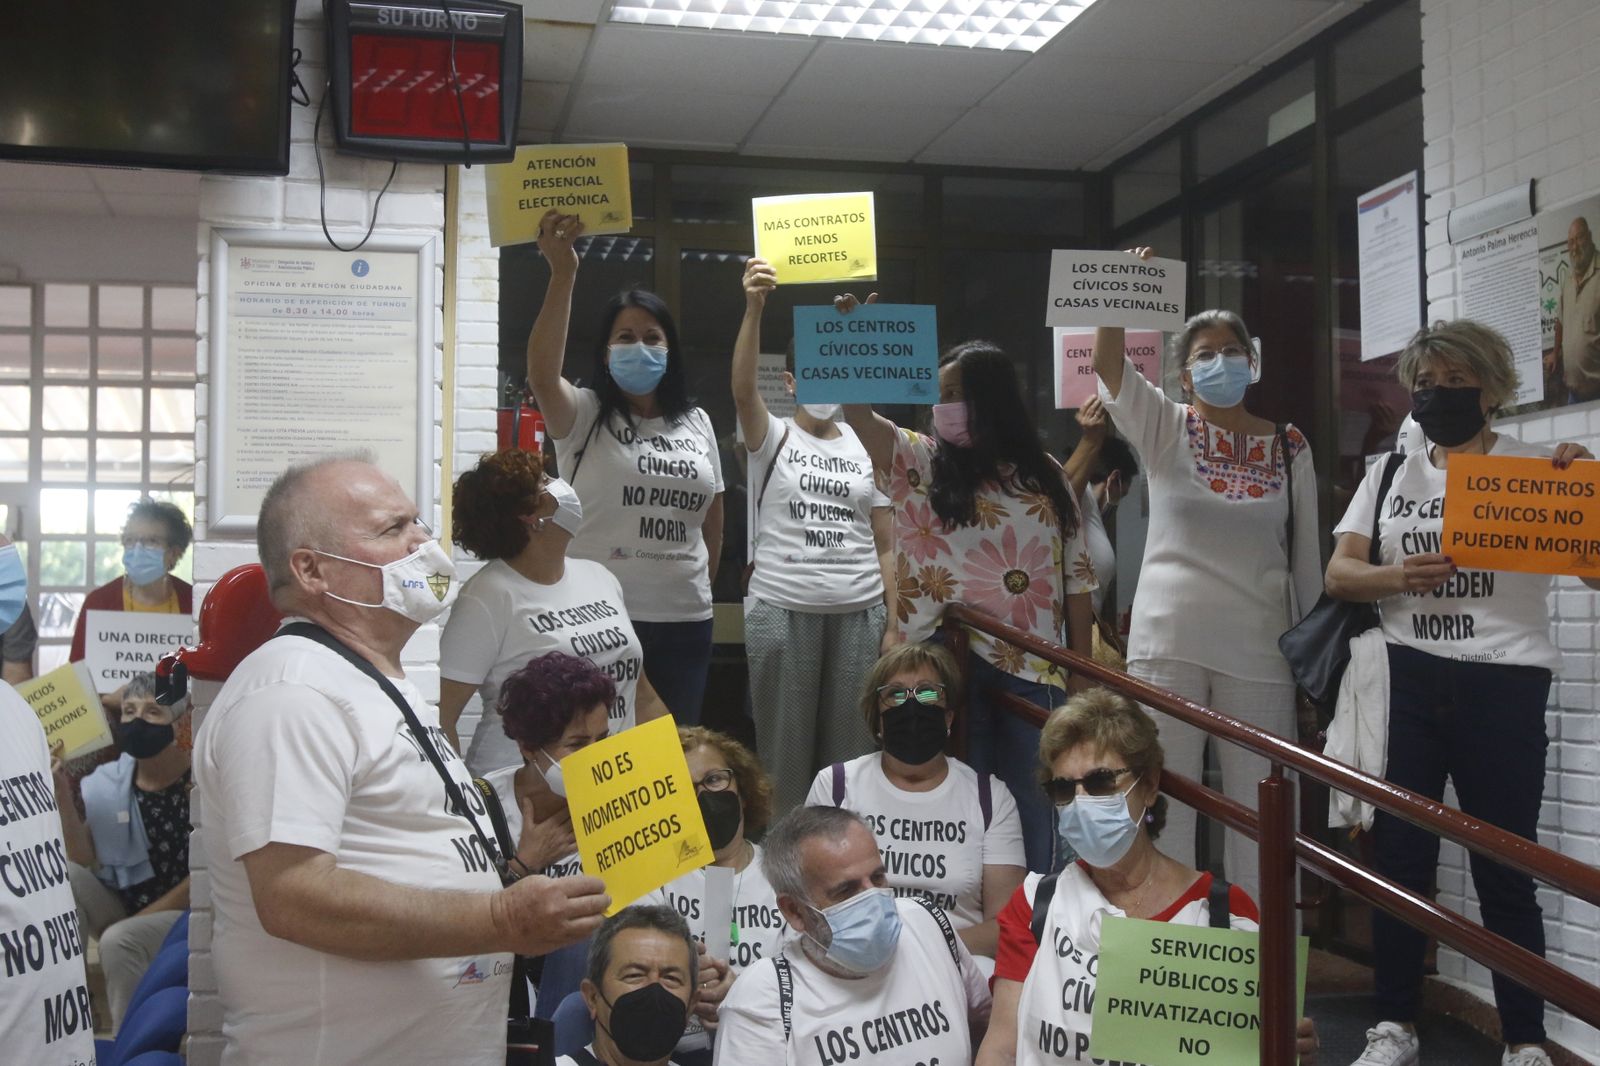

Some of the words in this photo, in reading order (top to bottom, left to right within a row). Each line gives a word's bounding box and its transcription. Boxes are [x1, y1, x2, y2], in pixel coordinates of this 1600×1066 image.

[378, 8, 403, 26] SU
[408, 10, 478, 31] TURNO
[526, 155, 596, 171] ATENCIÓN
[522, 175, 604, 190] PRESENCIAL
[518, 192, 610, 211] ELECTRÓNICA
[763, 218, 791, 232] MÁS
[793, 212, 866, 229] CONTRATOS
[793, 233, 839, 247] MENOS
[1462, 244, 1487, 260] Antonio
[1507, 227, 1538, 245] Herencia
[788, 250, 848, 266] RECORTES
[1072, 263, 1098, 274] LOS
[1102, 263, 1167, 278] CENTROS
[244, 280, 283, 288] OFICINA
[300, 280, 347, 290] ATENCIÓN
[350, 283, 403, 291] CIUDADANA
[1072, 278, 1129, 292] CÍVICOS
[1132, 282, 1163, 295] SON
[239, 296, 281, 304] HORARIO
[299, 297, 354, 306] EXPEDICIÓN
[352, 309, 375, 317] horas
[1054, 297, 1099, 309] CASAS
[1103, 297, 1180, 314] VECINALES
[815, 320, 843, 334] LOS
[847, 320, 916, 334] CENTROS
[819, 340, 881, 357] CÍVICOS
[882, 343, 913, 357] SON
[1066, 348, 1093, 359] CENT
[1126, 345, 1156, 357] VICOS
[801, 366, 850, 380] CASAS
[853, 366, 933, 380] VECINALES
[637, 452, 699, 480] CÍVICOS
[788, 448, 807, 468] LOS
[810, 454, 862, 475] CENTROS
[799, 471, 851, 498] CÍVICOS
[1466, 475, 1501, 492] LOS
[1506, 478, 1595, 498] CENTROS
[622, 485, 646, 507] NO
[649, 487, 707, 513] PUEDEN
[788, 500, 807, 520] NO
[810, 502, 856, 523] PUEDEN
[1473, 501, 1548, 524] CÍVICOS
[1553, 510, 1584, 526] NO
[639, 516, 687, 543] MORIR
[804, 529, 846, 549] MORIR
[1401, 526, 1442, 556] CÍVI
[1452, 531, 1529, 551] PUEDEN
[1534, 536, 1600, 556] MORIR
[528, 610, 564, 634] LOS
[558, 599, 619, 627] CENTROS
[1412, 613, 1476, 641] MORIR
[98, 631, 131, 644] UNA
[570, 625, 628, 658] CÍVICOS
[115, 651, 154, 663] PARA
[101, 668, 144, 680] CENT
[24, 682, 55, 705] VICIOS
[36, 701, 58, 719] ICOS
[57, 695, 68, 705] SI
[44, 704, 88, 736] ZACIONES
[591, 759, 614, 786] NO
[616, 751, 634, 774] ES
[0, 771, 58, 827] ENTROS
[581, 783, 651, 836] MOMENTO
[656, 774, 678, 798] DE
[595, 813, 682, 873] RETROCESOS
[889, 818, 967, 844] CENTROS
[450, 833, 488, 873] NO
[0, 837, 70, 898] CÍVICOS
[669, 891, 700, 921] LOS
[0, 923, 46, 978] NO
[1150, 937, 1256, 965] SERVICIOS
[1139, 966, 1238, 997] PÚBLICOS
[43, 985, 93, 1045] MOR
[1107, 997, 1260, 1031] PRIVATIZACION
[814, 1026, 861, 1066] LOS
[861, 999, 950, 1055] CENTROS
[1039, 1019, 1069, 1058] NO
[1178, 1037, 1211, 1056] NO
